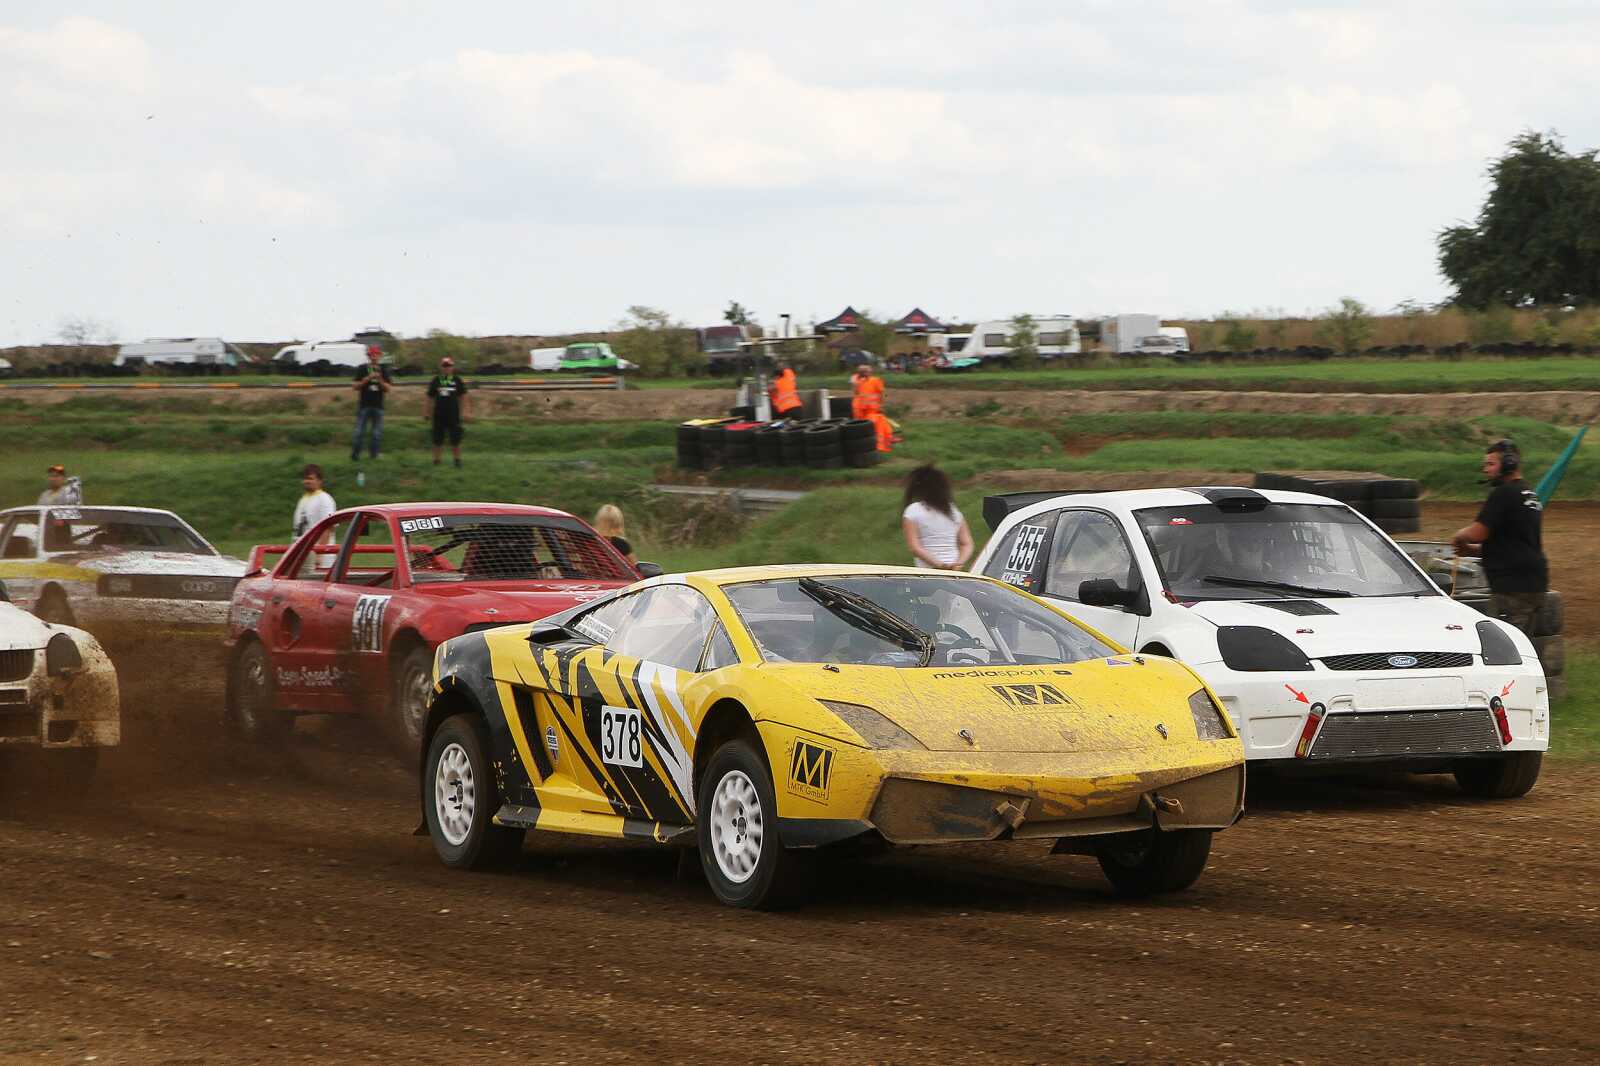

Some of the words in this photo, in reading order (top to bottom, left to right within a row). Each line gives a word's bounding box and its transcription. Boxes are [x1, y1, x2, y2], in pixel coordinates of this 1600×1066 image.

[1008, 526, 1043, 571] 355
[933, 668, 1046, 681] mediasport
[603, 712, 640, 761] 378
